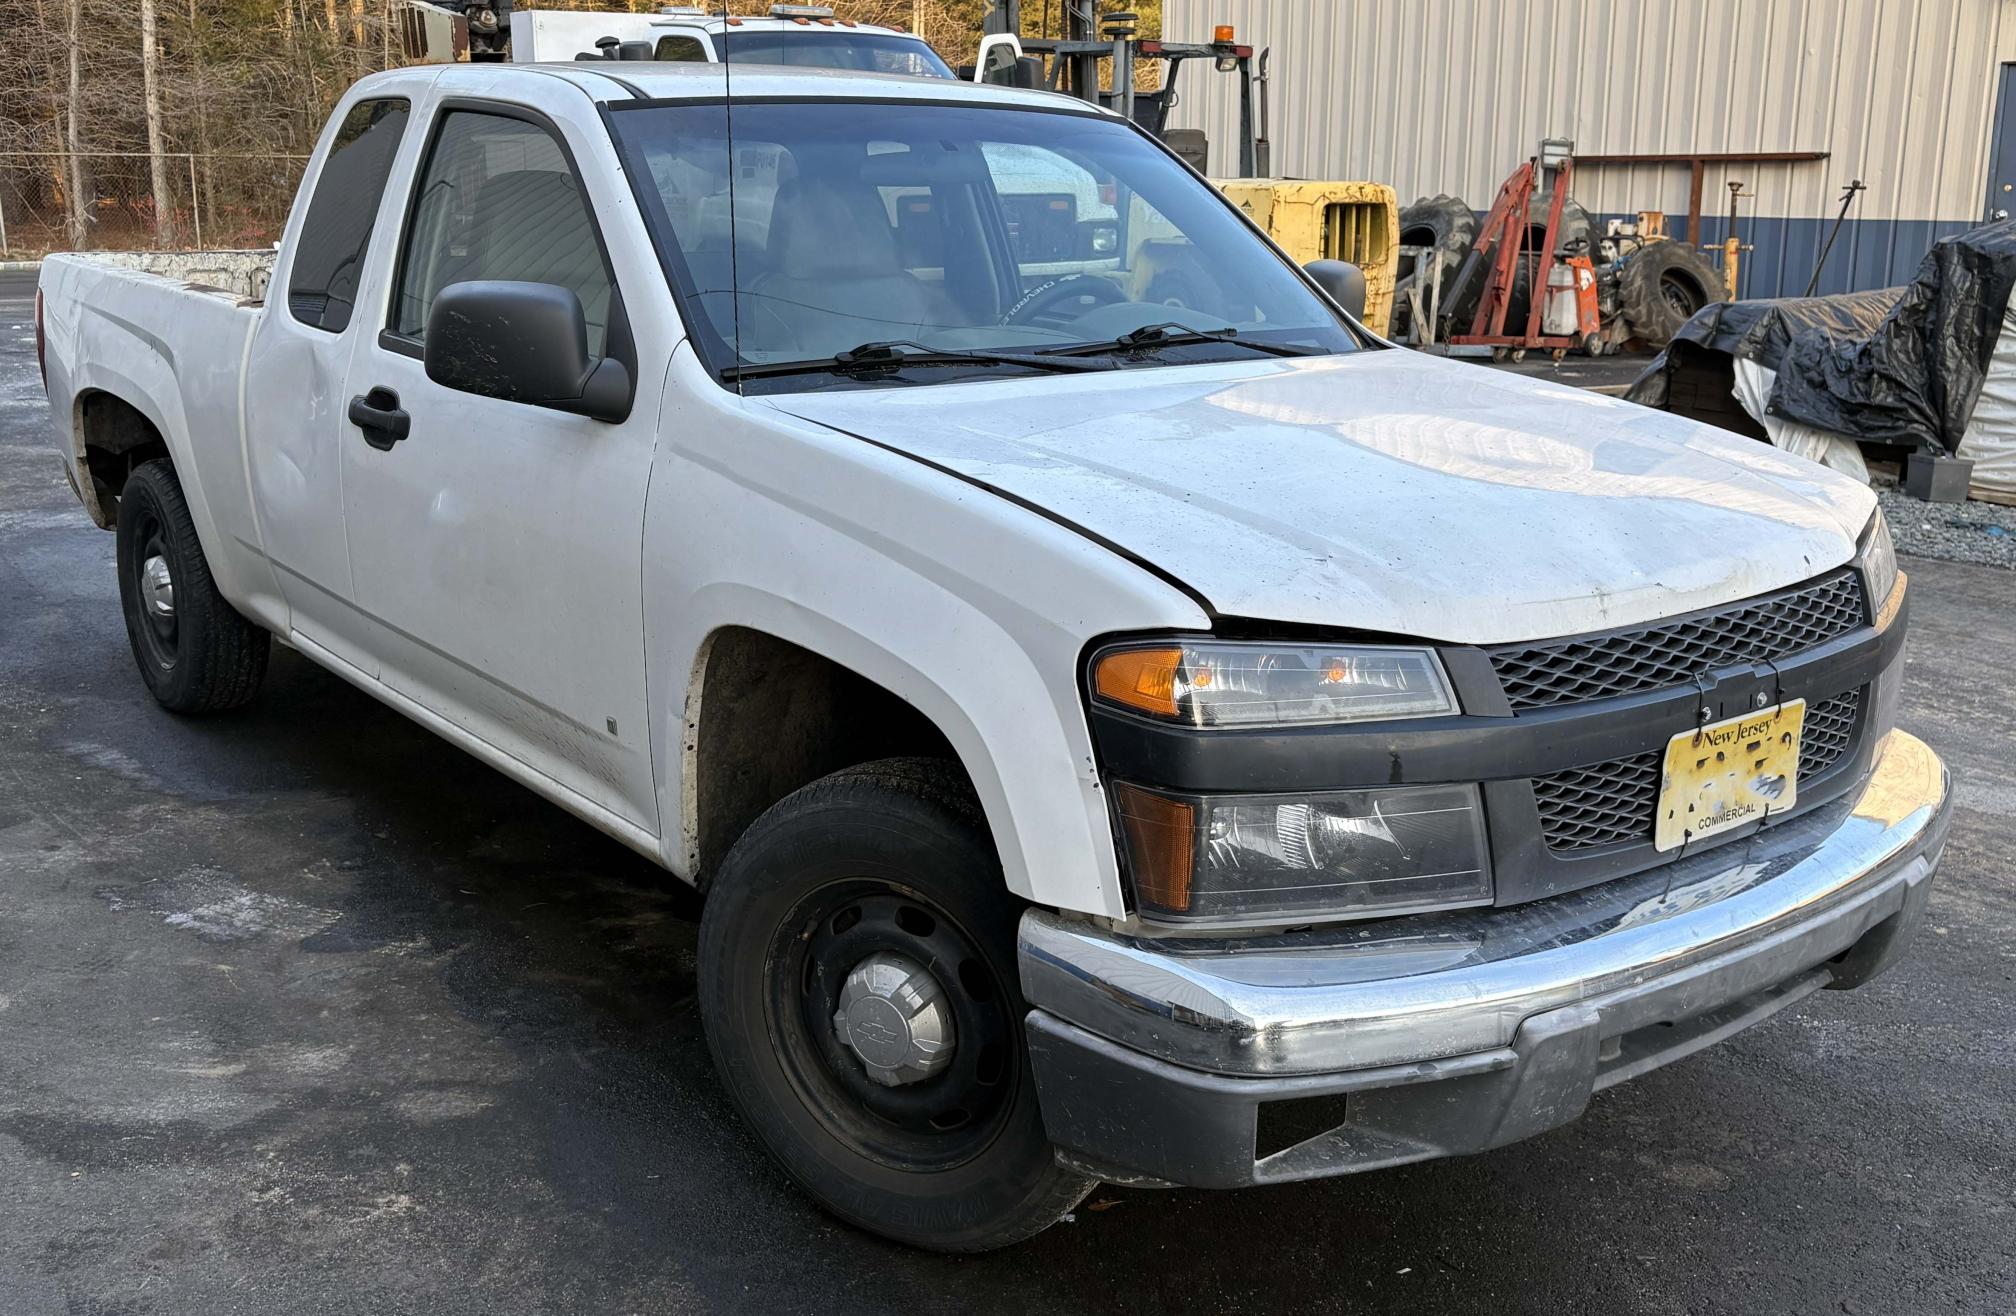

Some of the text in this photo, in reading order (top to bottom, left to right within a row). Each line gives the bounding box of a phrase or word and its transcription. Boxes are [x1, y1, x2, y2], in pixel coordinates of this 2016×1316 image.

[1702, 719, 1773, 749] New Jersey
[1698, 803, 1756, 830] COMMERCIAL
